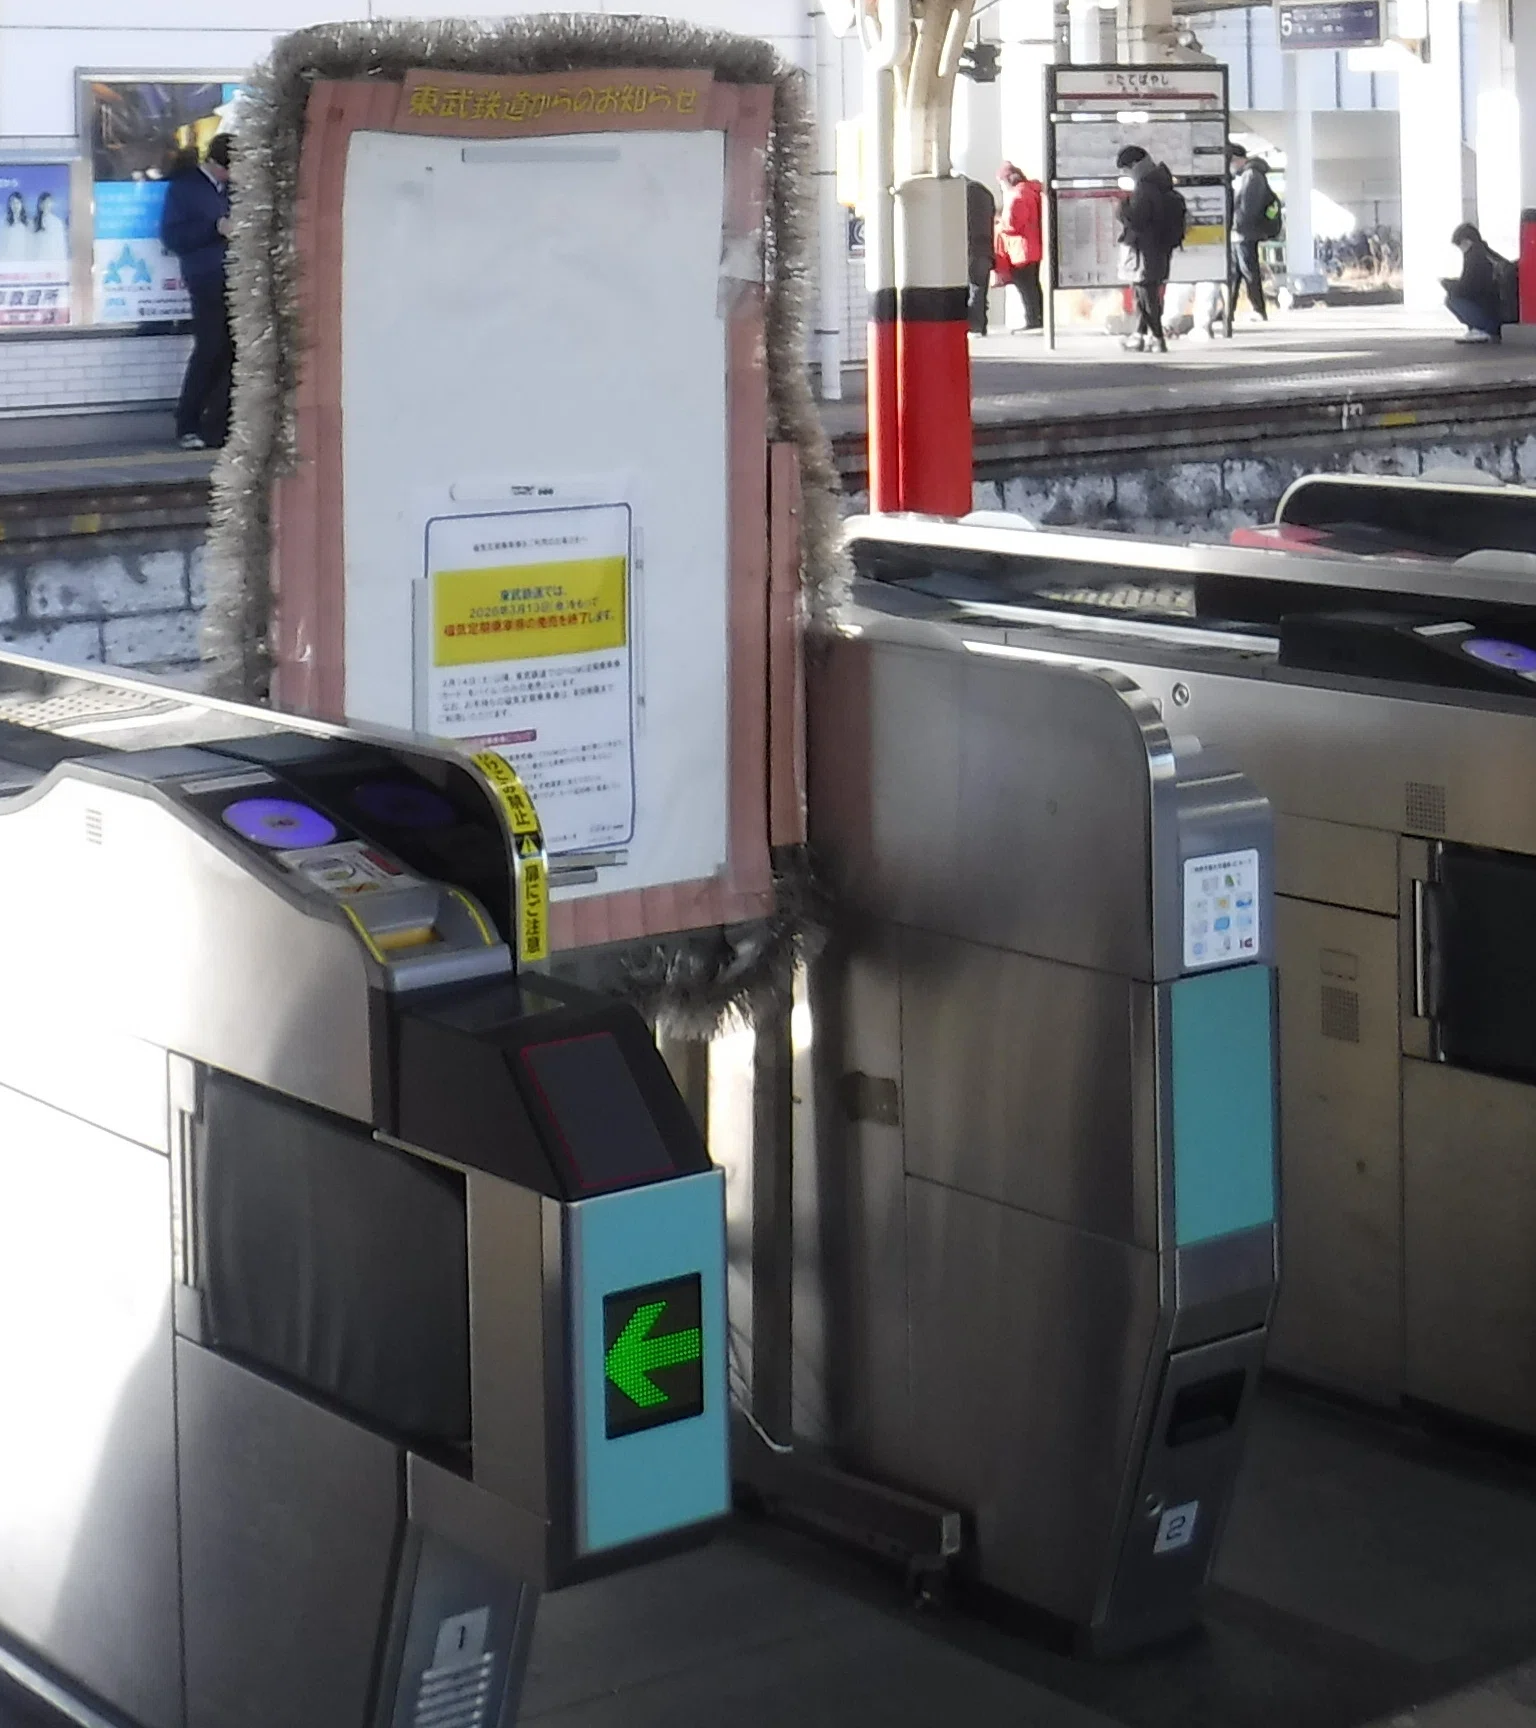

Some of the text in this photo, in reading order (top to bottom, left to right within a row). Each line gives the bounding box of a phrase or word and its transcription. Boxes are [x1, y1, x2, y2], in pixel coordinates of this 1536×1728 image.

[1281, 12, 1292, 36] 5
[1116, 73, 1170, 85] たてばやし
[408, 83, 700, 122] 東武鉄道からのお知らせ
[1166, 1515, 1186, 1541] 2
